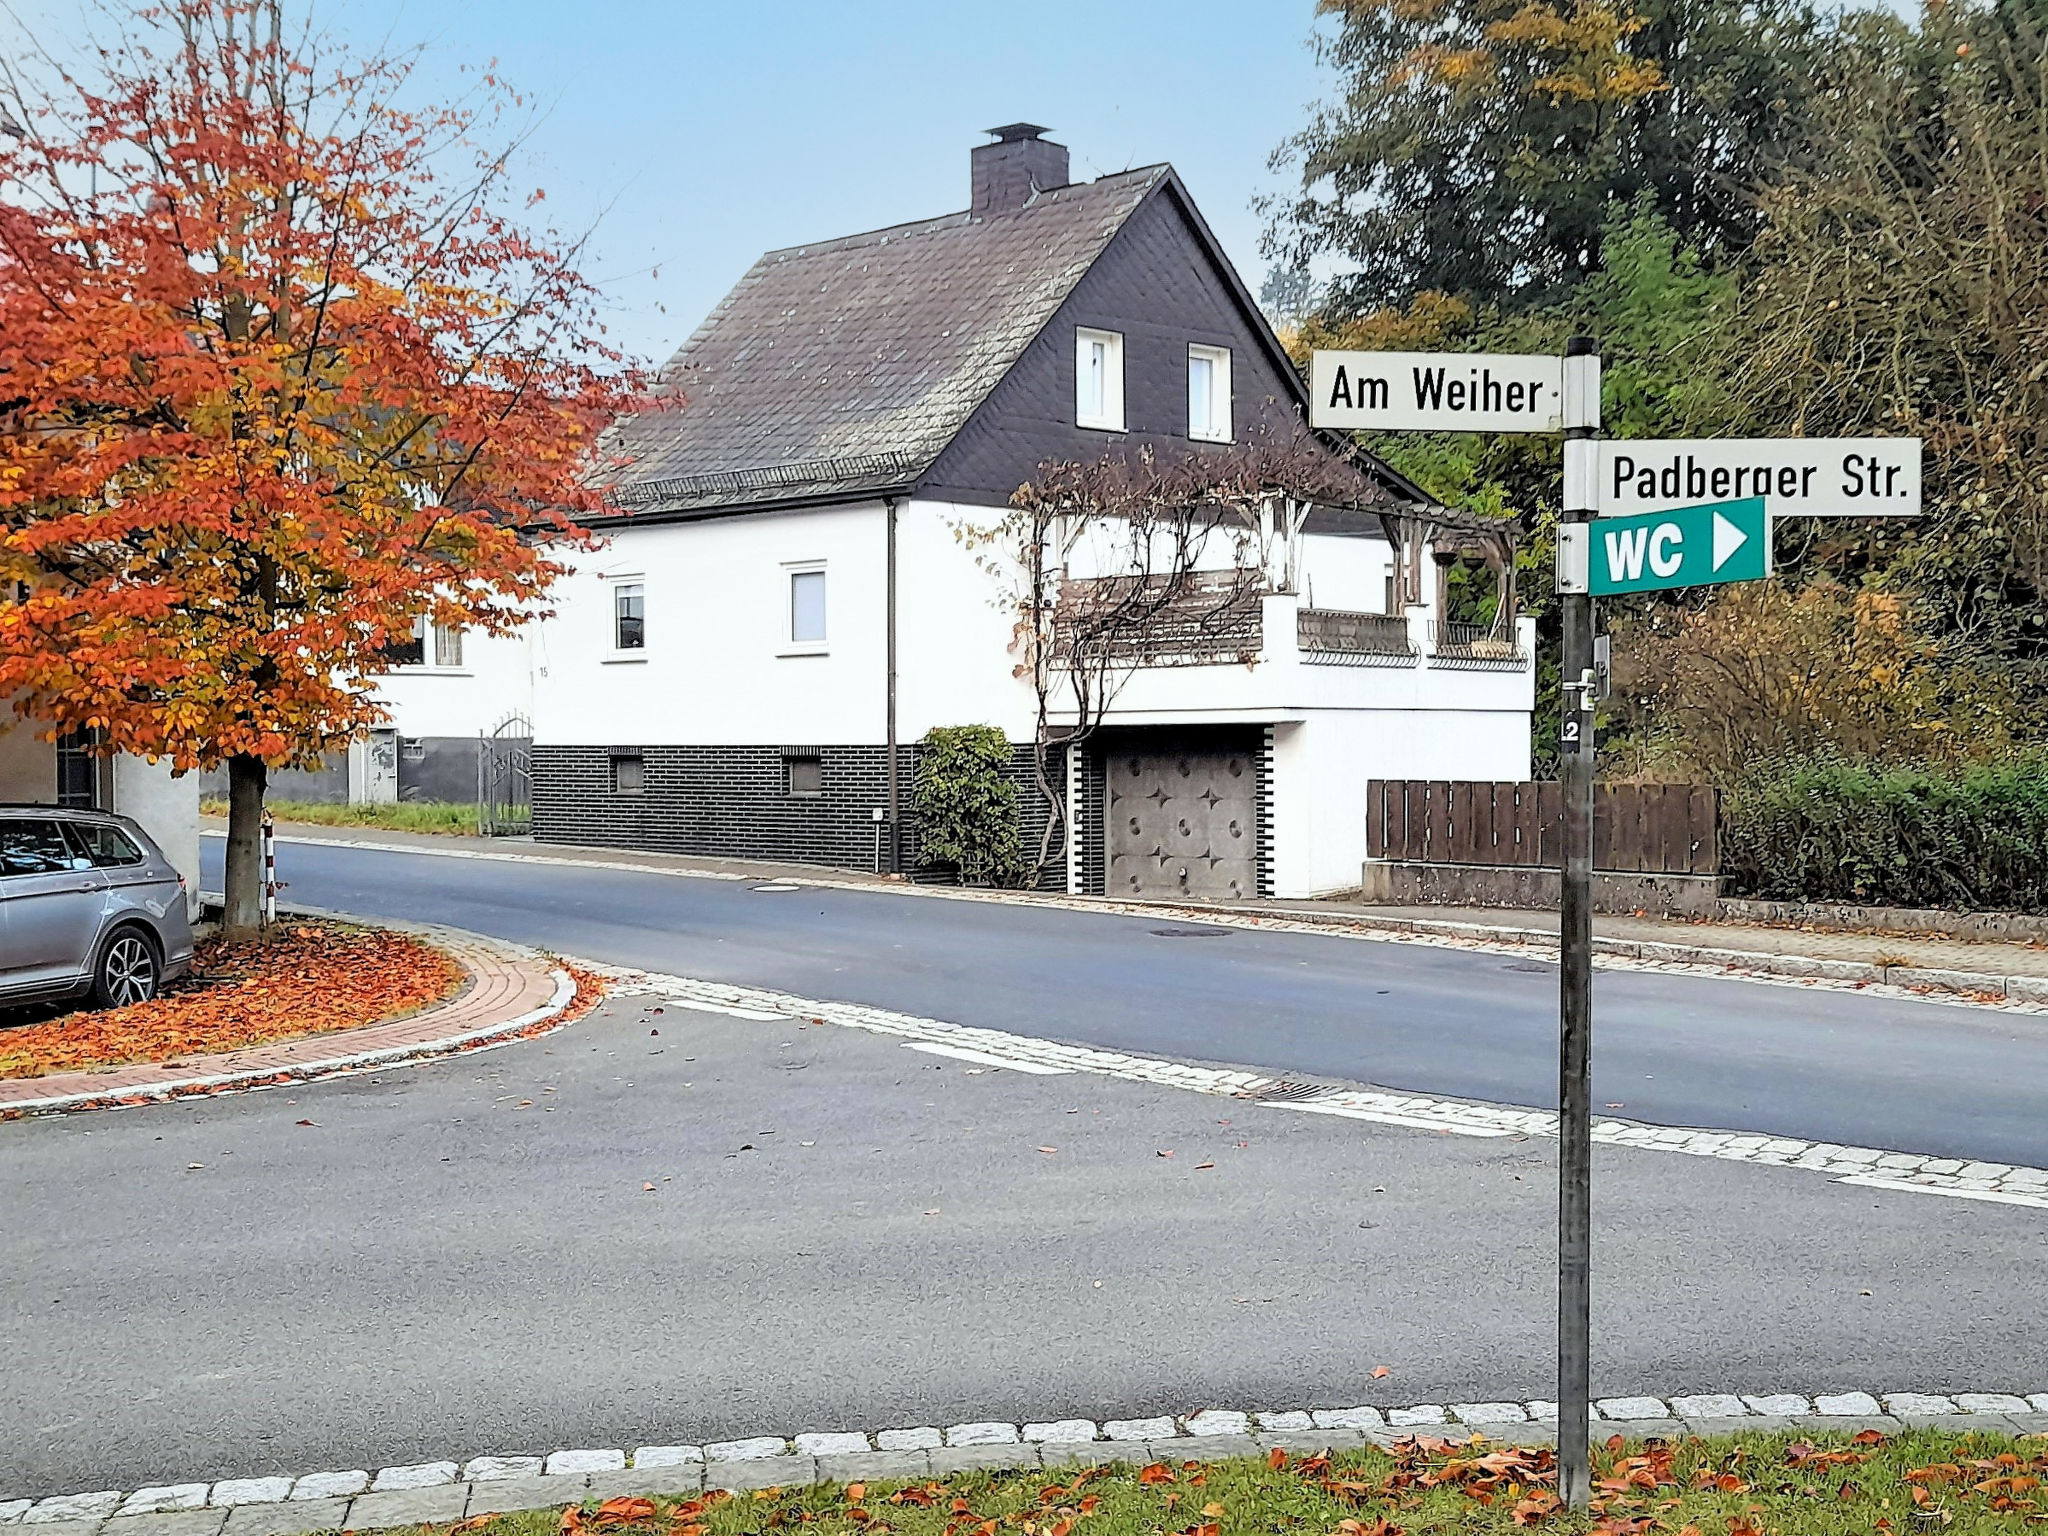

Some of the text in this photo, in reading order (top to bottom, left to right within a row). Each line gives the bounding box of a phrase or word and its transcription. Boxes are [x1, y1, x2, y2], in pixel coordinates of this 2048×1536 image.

[1329, 364, 1543, 413] Am Weiher
[1613, 453, 1907, 499] Padberger Str.
[1604, 522, 1684, 583] WC
[539, 666, 549, 678] 15
